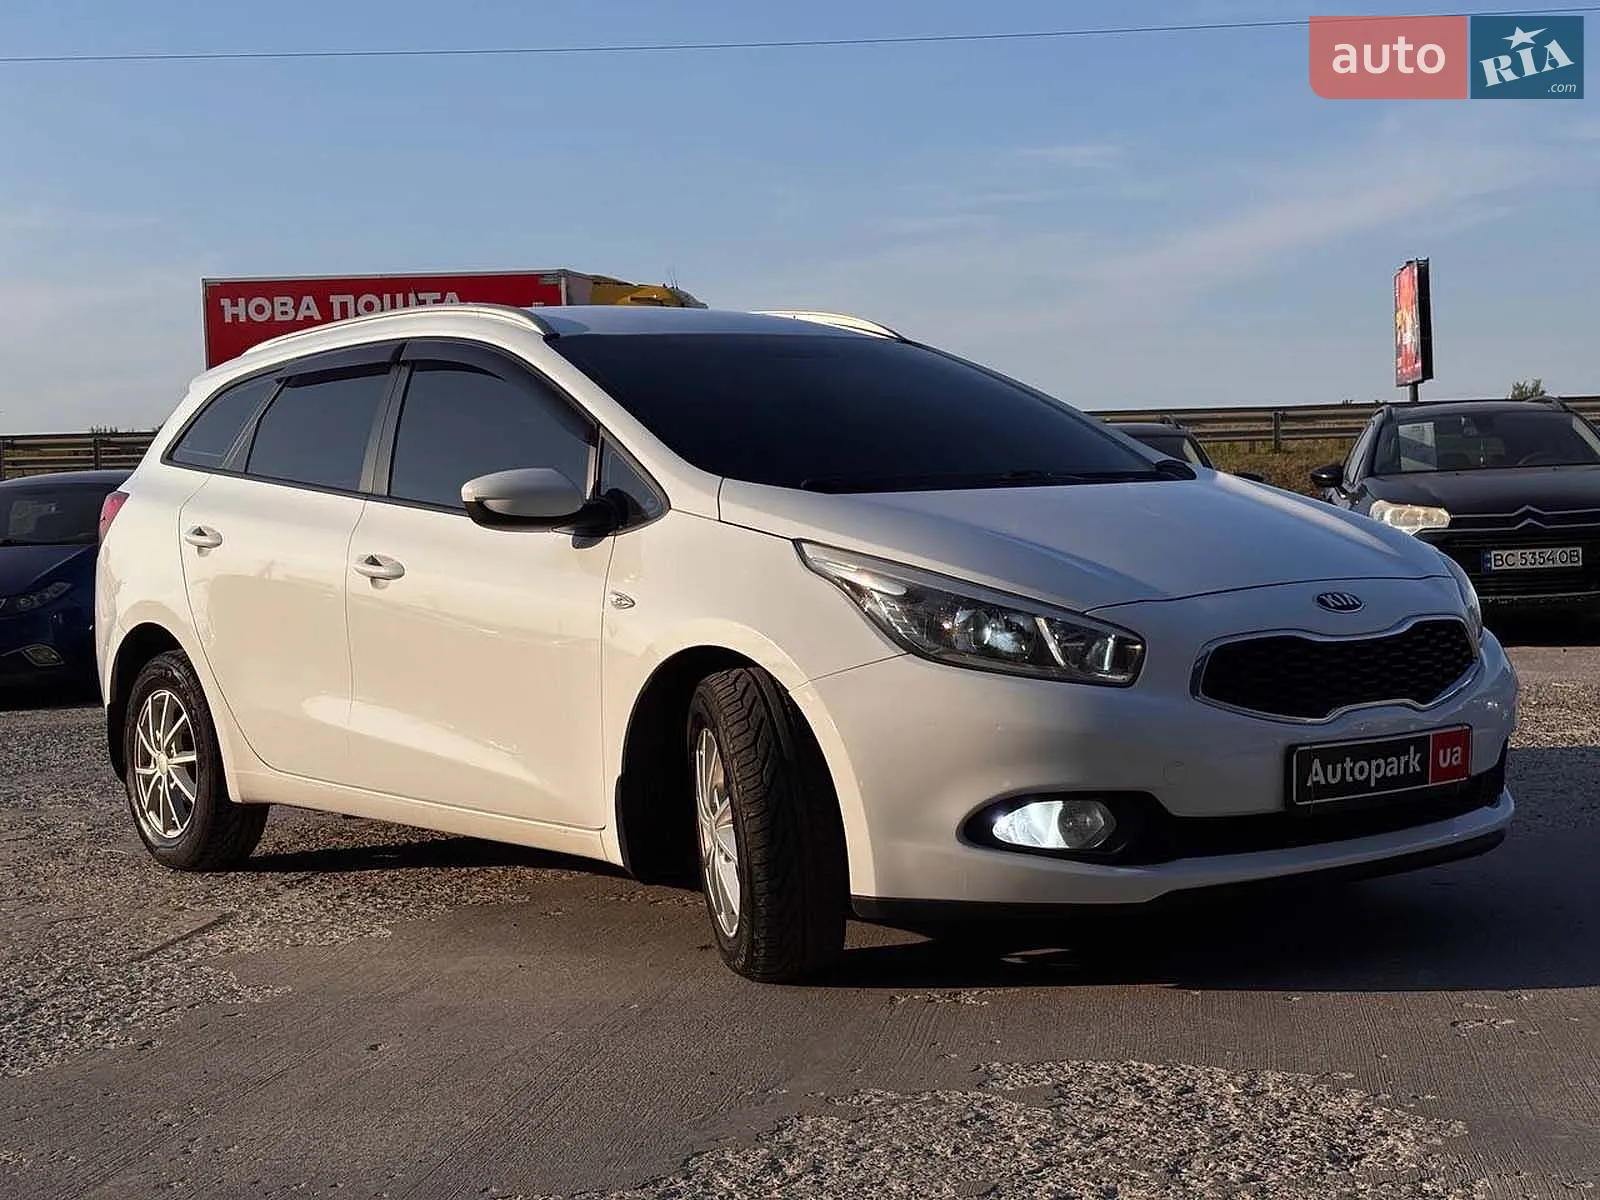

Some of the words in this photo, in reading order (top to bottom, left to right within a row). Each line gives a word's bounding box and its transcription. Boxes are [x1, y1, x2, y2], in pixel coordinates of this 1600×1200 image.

[221, 295, 323, 323] НОВА
[1493, 553, 1516, 568] BC
[1519, 551, 1555, 566] 5354
[1558, 549, 1580, 565] OB
[1319, 594, 1361, 608] KIA
[1307, 745, 1422, 787] Autopark
[1439, 746, 1462, 769] ua
